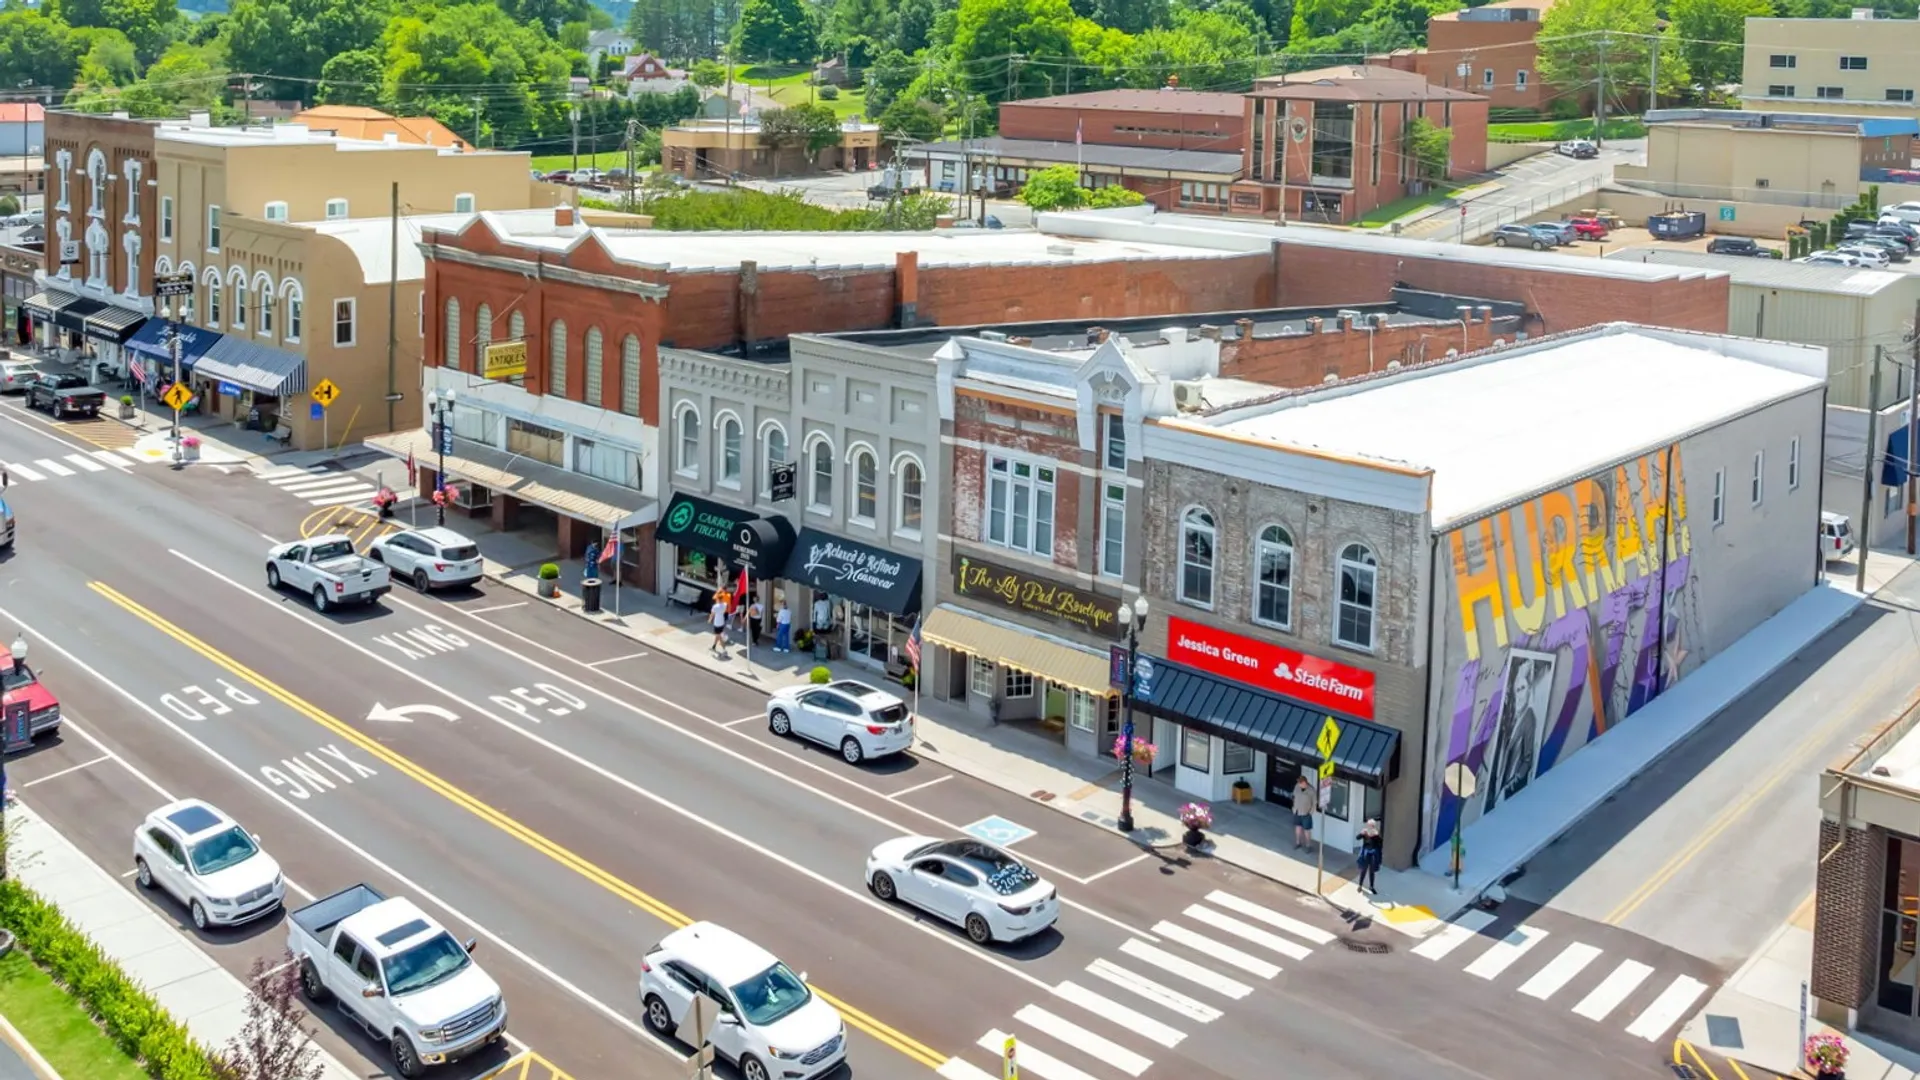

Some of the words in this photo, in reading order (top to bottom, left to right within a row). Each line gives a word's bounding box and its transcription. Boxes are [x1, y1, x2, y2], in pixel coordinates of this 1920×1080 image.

[489, 353, 526, 366] ANTIQUES
[693, 523, 728, 542] FIREAR
[1451, 441, 1692, 661] HURRAH!
[822, 542, 858, 563] Relaxed
[857, 552, 866, 565] &
[867, 554, 901, 576] Refined
[835, 562, 895, 589] Menswear
[969, 567, 993, 588] The
[993, 575, 1020, 604] Lily
[1021, 581, 1057, 606] Pad
[1056, 592, 1114, 628] Boutique
[372, 624, 470, 661] XING
[1177, 634, 1220, 658] Jessica
[1222, 647, 1259, 669] Green
[159, 678, 261, 721] PED
[488, 683, 588, 724] PED
[259, 744, 378, 799] XING
